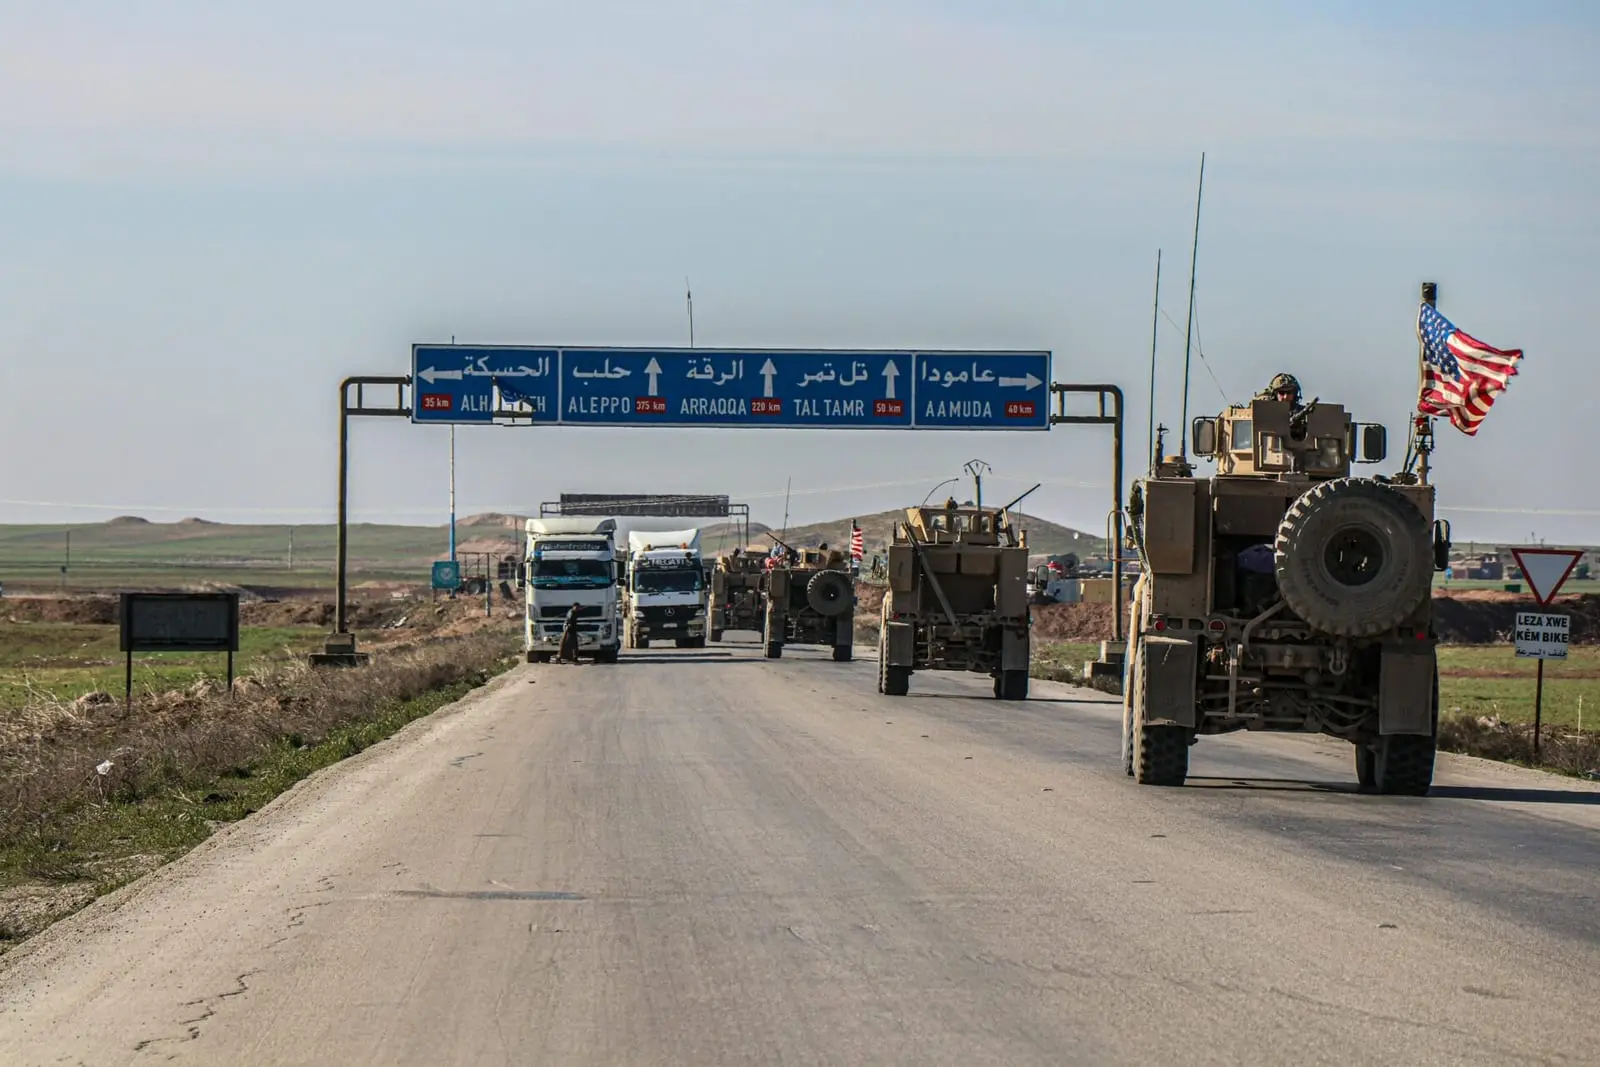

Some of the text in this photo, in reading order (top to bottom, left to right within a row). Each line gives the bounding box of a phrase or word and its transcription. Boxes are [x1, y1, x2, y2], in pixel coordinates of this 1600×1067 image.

[463, 355, 550, 377] الحسكة
[572, 357, 632, 386] حلب
[686, 357, 744, 386] الرقة
[796, 361, 868, 388] تل تمر
[922, 360, 996, 388] عامودا
[424, 398, 449, 407] 35 km
[568, 396, 631, 414] ALEPPO
[636, 401, 666, 410] 375 km
[680, 398, 747, 416] ARRAQQA
[751, 402, 781, 412] 220 km
[793, 399, 865, 417] TAL TAMR
[876, 403, 901, 413] 50 km
[925, 400, 993, 418] AAMUDA
[1007, 404, 1032, 414] 40 km
[1518, 615, 1567, 627] LEZA XWE
[1542, 632, 1569, 643] BIKE
